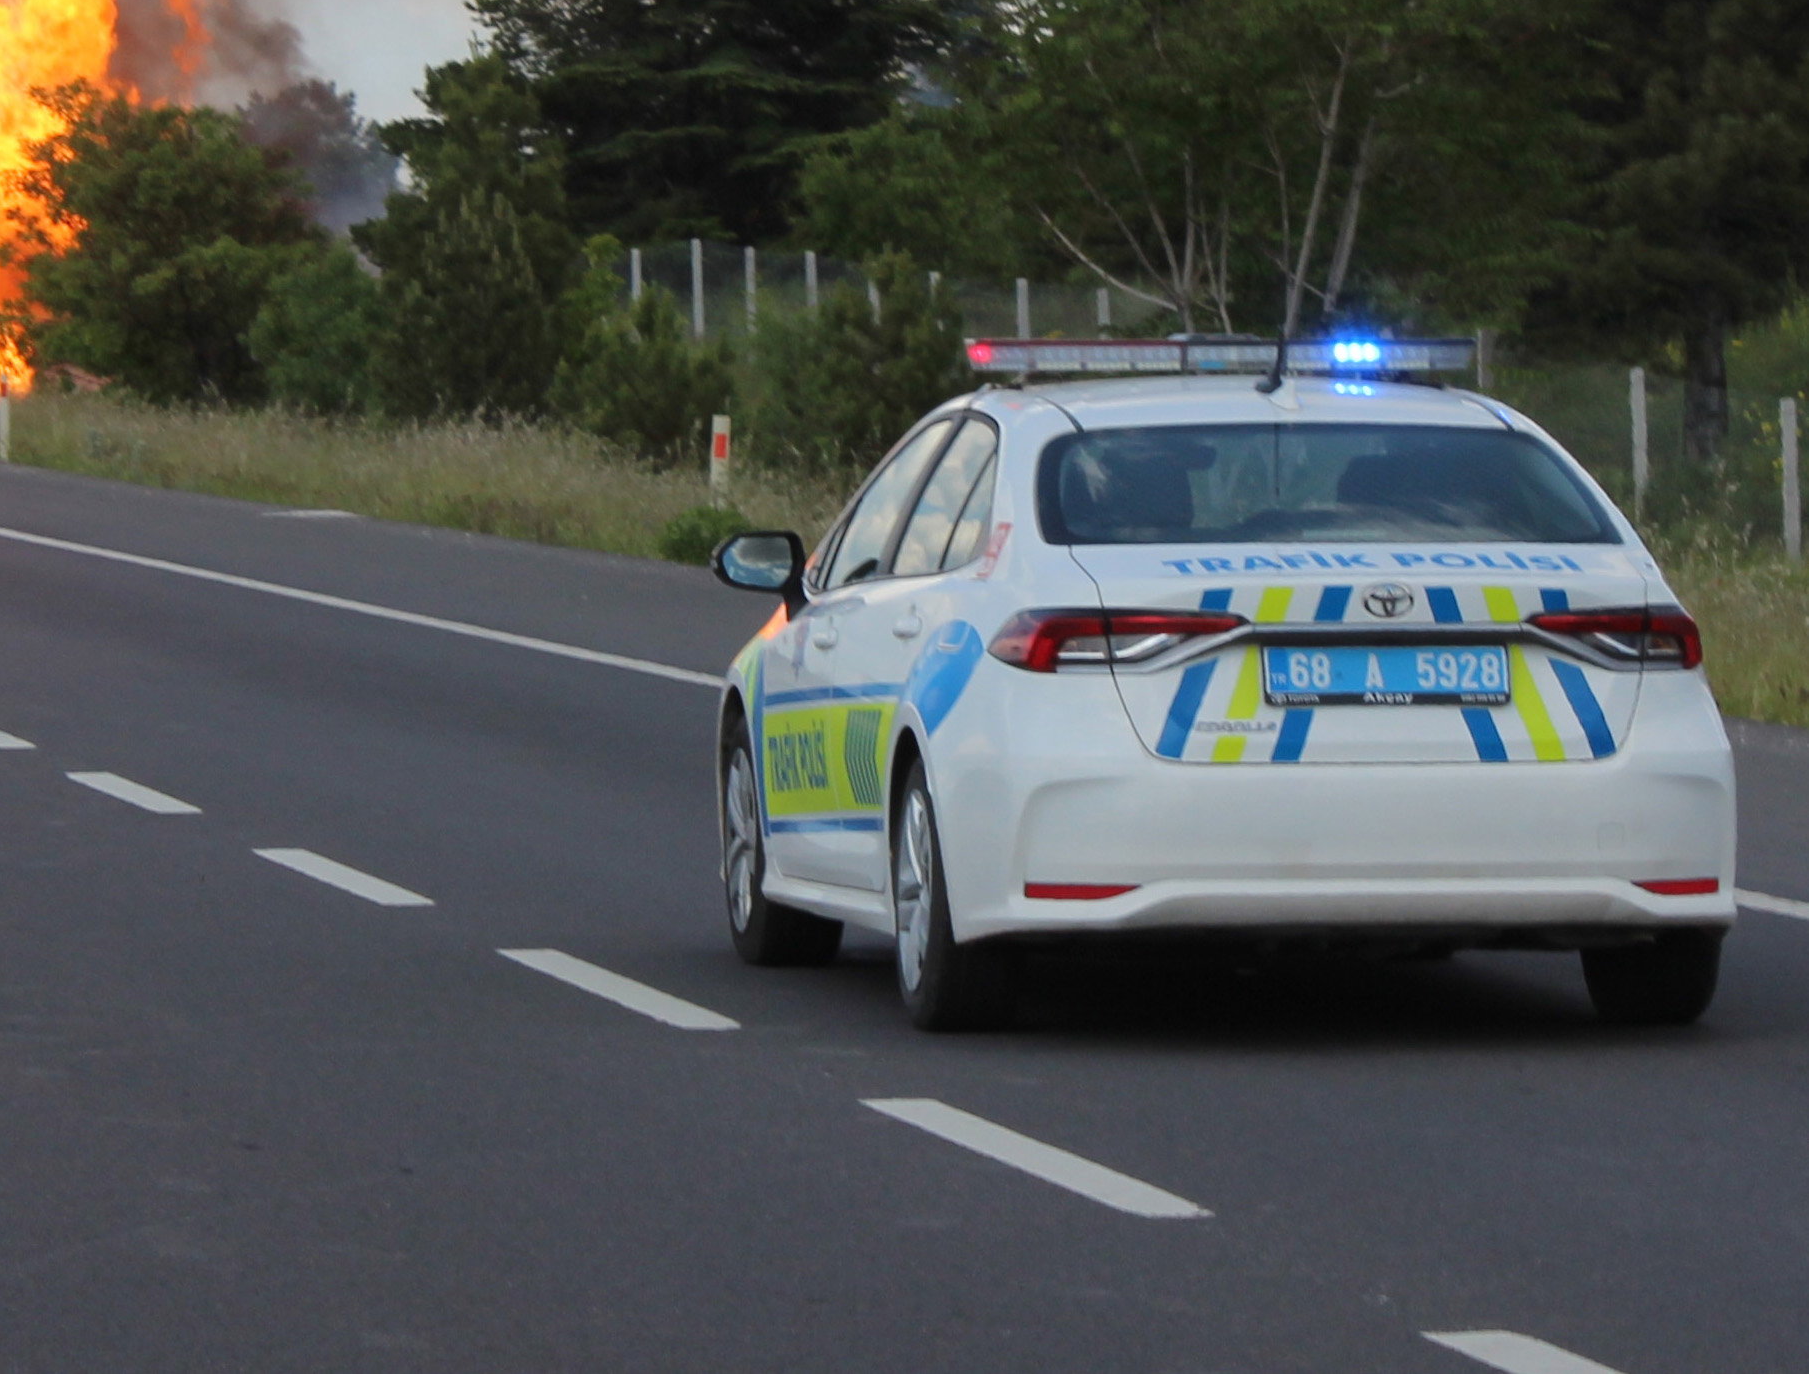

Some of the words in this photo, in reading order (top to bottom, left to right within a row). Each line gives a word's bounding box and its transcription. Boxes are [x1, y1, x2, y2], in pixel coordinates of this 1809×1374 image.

[1161, 550, 1379, 575] TRAFİK
[1272, 672, 1287, 685] TR
[1289, 651, 1331, 689] 68
[1365, 652, 1384, 689] A
[1416, 651, 1501, 689] 5928
